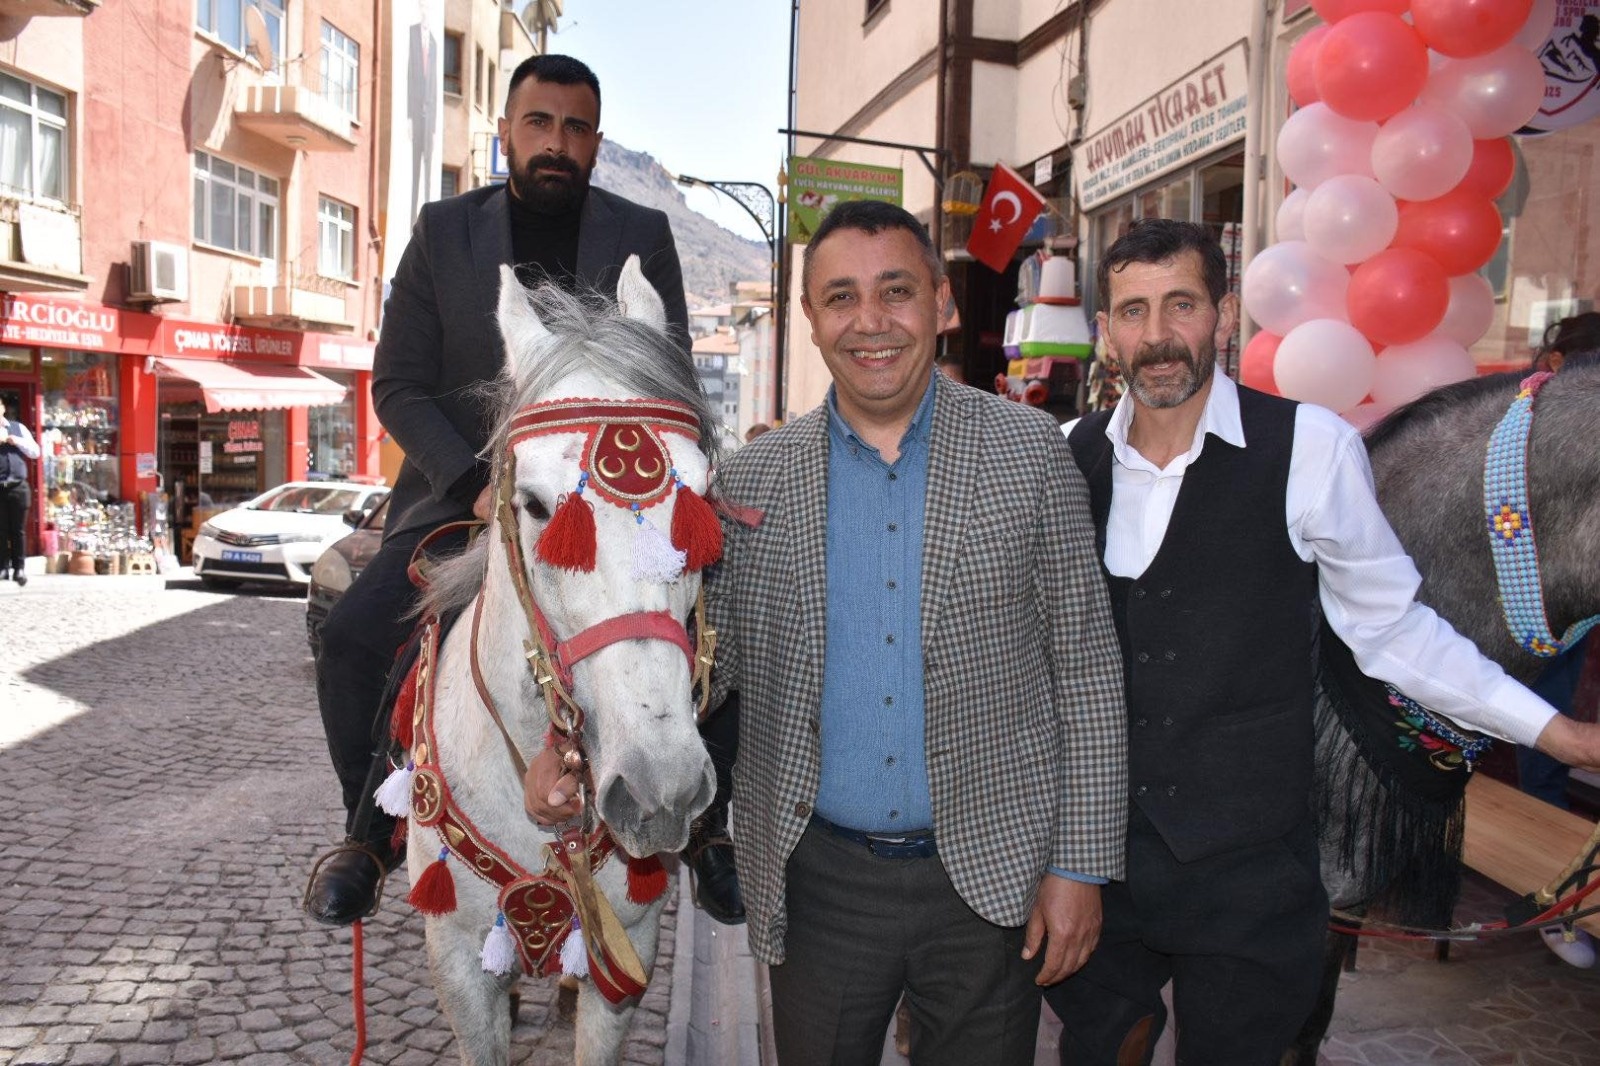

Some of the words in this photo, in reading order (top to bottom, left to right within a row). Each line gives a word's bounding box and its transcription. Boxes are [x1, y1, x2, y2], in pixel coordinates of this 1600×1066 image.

[1086, 114, 1146, 173] KAYMAK
[1148, 62, 1227, 137] TİCARET
[796, 161, 820, 176] GÜL
[825, 166, 898, 185] AKVARYUM
[816, 180, 864, 194] HAYVANLAR
[174, 328, 211, 353] ÇINAR
[254, 332, 293, 356] ÜRÜNLER
